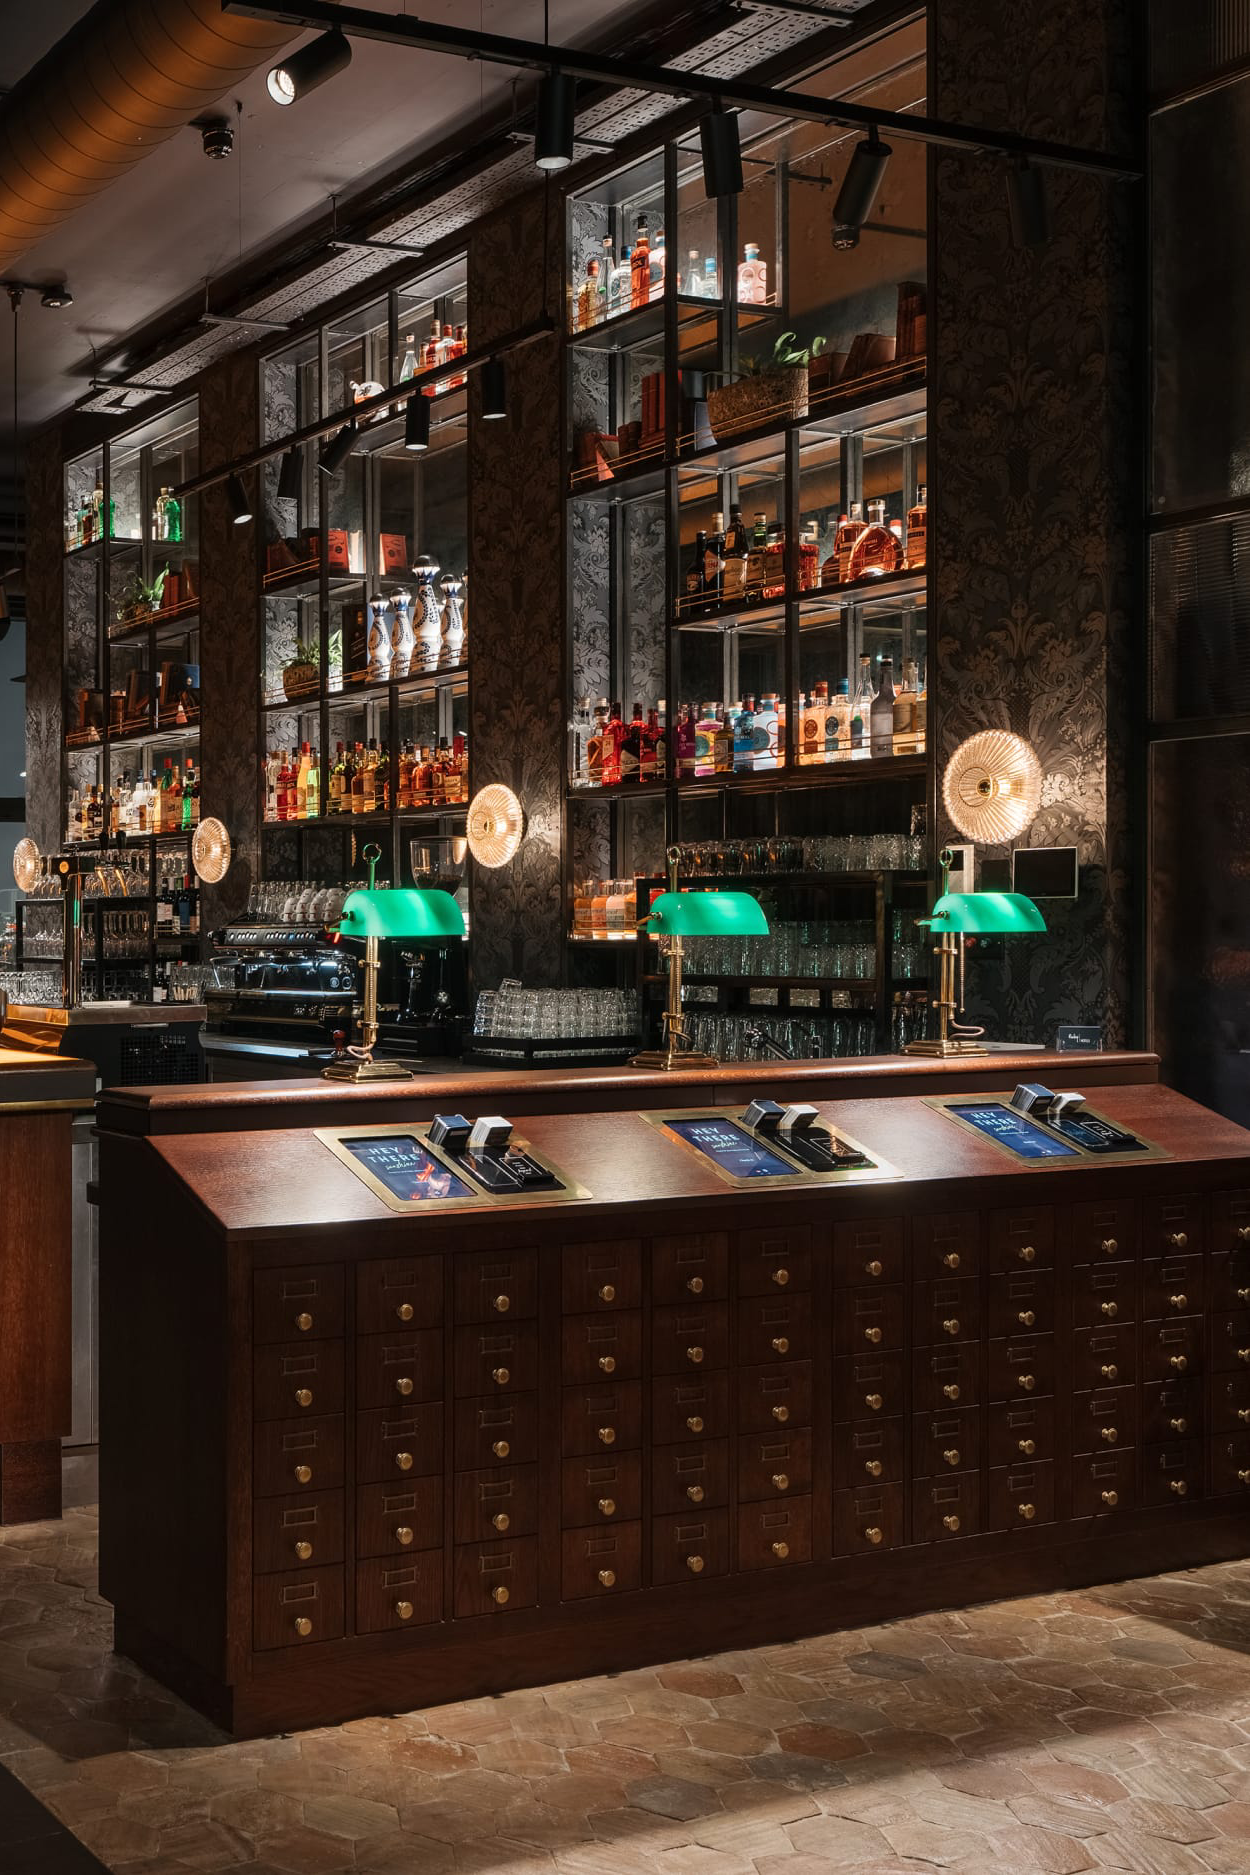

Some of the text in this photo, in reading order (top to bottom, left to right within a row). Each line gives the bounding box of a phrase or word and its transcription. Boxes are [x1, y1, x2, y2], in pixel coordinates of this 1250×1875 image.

[974, 1118, 1017, 1126] THERE
[691, 1127, 719, 1135] HEY
[692, 1134, 740, 1142] THERE
[368, 1146, 399, 1155] HEY
[367, 1153, 420, 1163] THERE
